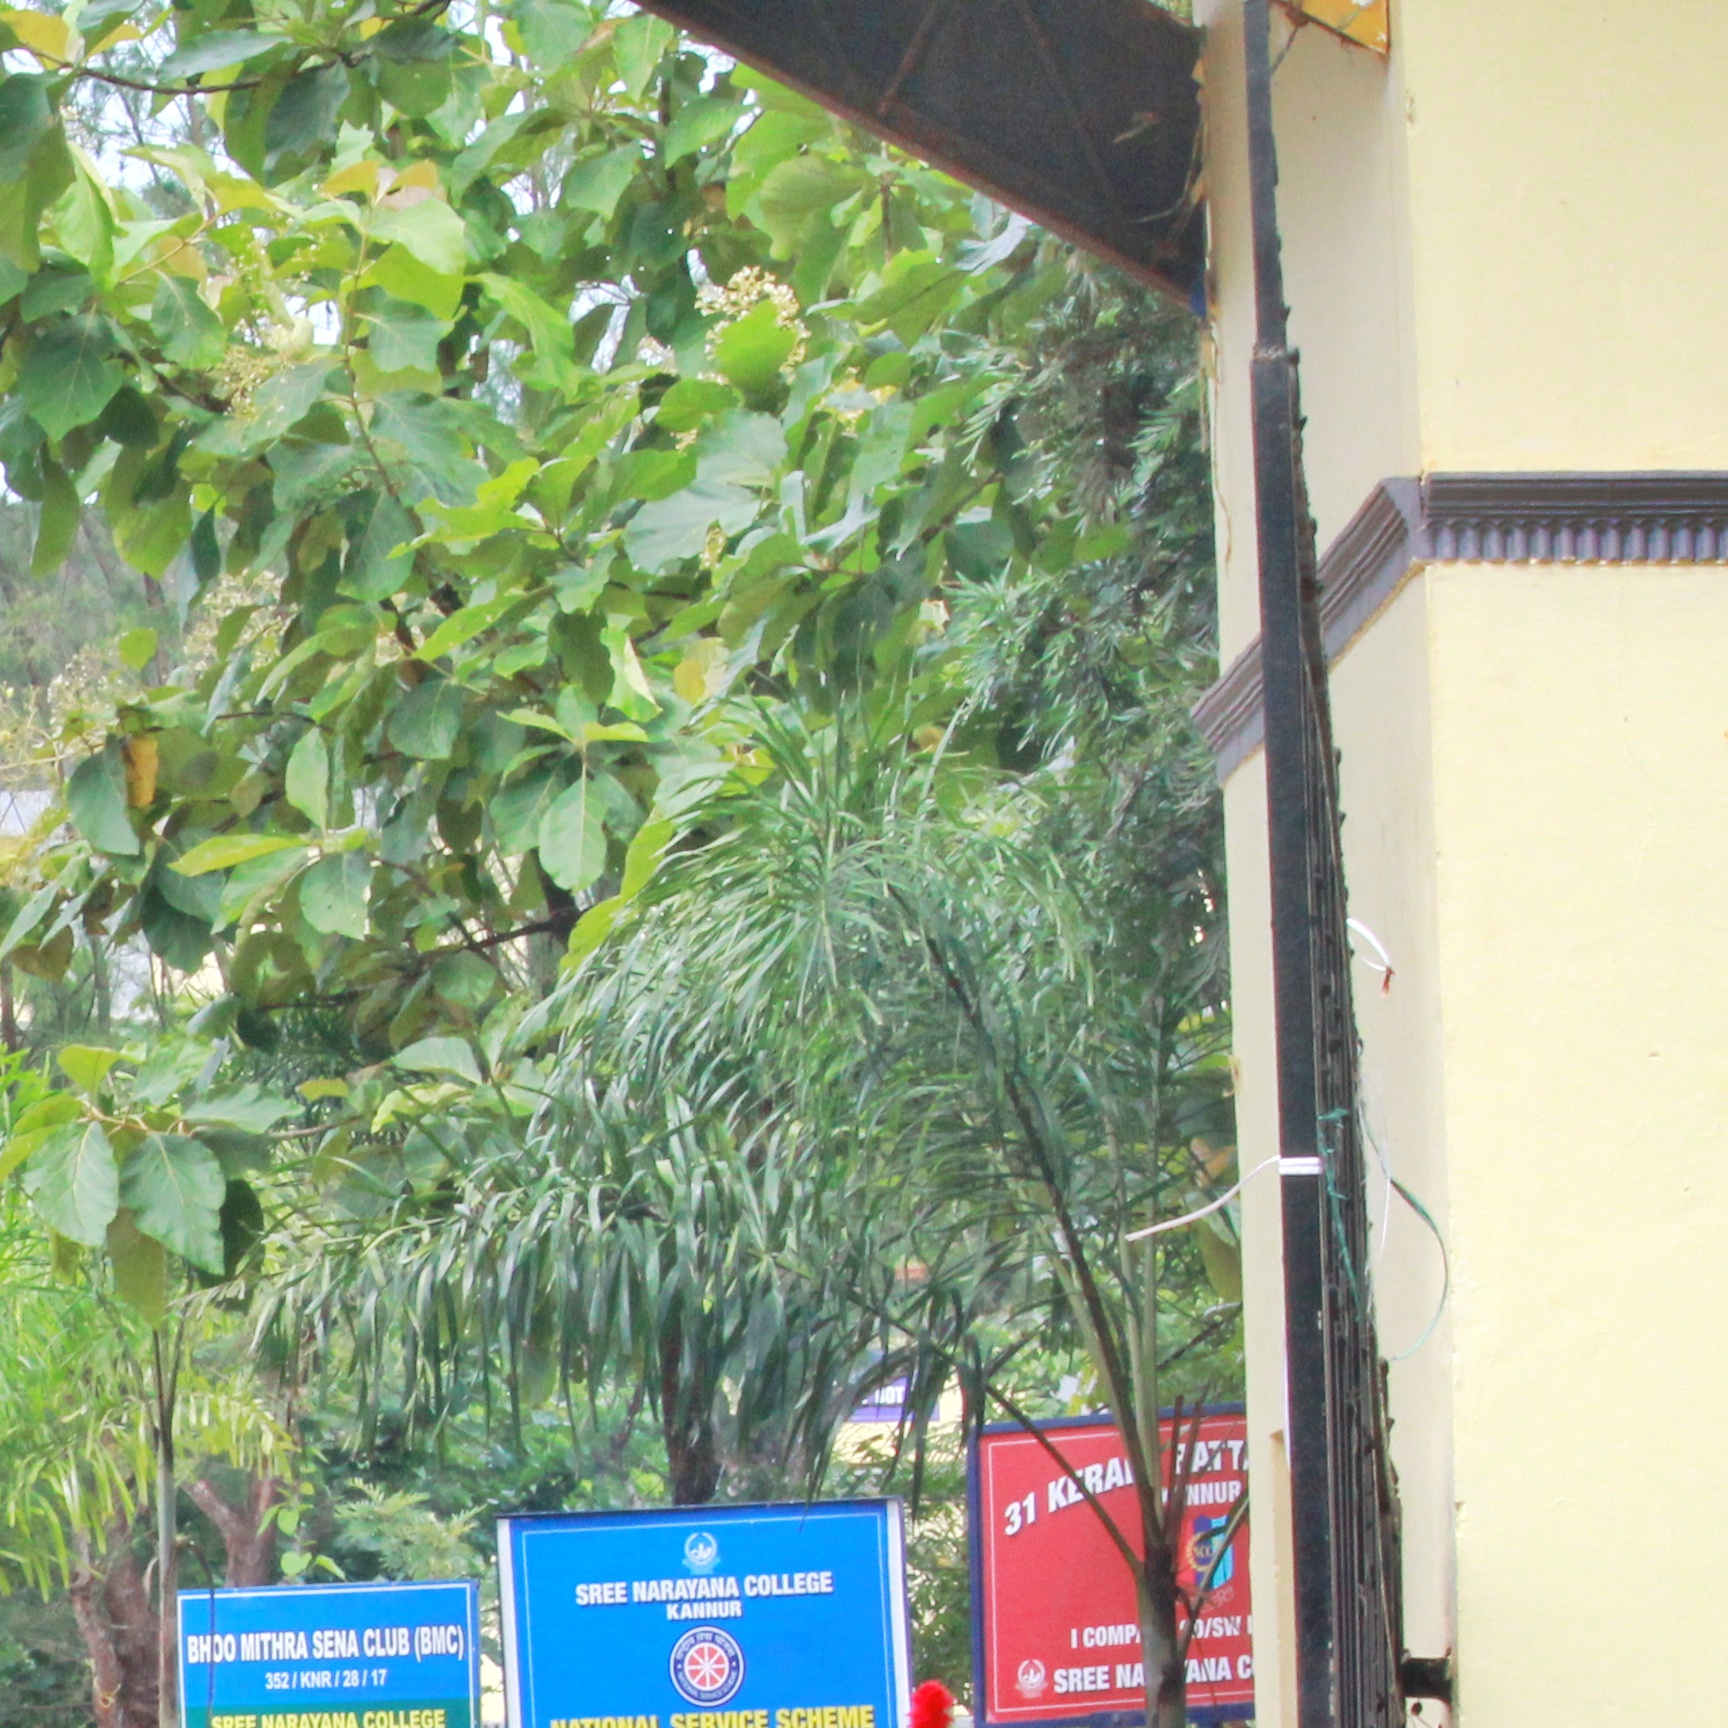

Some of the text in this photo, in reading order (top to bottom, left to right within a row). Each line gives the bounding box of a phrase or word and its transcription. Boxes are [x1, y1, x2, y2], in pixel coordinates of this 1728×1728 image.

[1004, 1491, 1037, 1536] 31
[575, 1571, 834, 1607] SREE NARAYANA COLLEGE
[666, 1600, 743, 1621] KANNUR
[240, 1631, 308, 1662] MITHRA
[312, 1628, 360, 1660] SENA
[363, 1627, 410, 1658] CLUB
[414, 1624, 464, 1662] (BMC)
[265, 1671, 290, 1690] 352
[300, 1670, 332, 1689] KNR
[342, 1669, 360, 1687] 28
[371, 1668, 387, 1686] 17
[1053, 1665, 1110, 1695] SREE
[1115, 1656, 1233, 1690] NAANA
